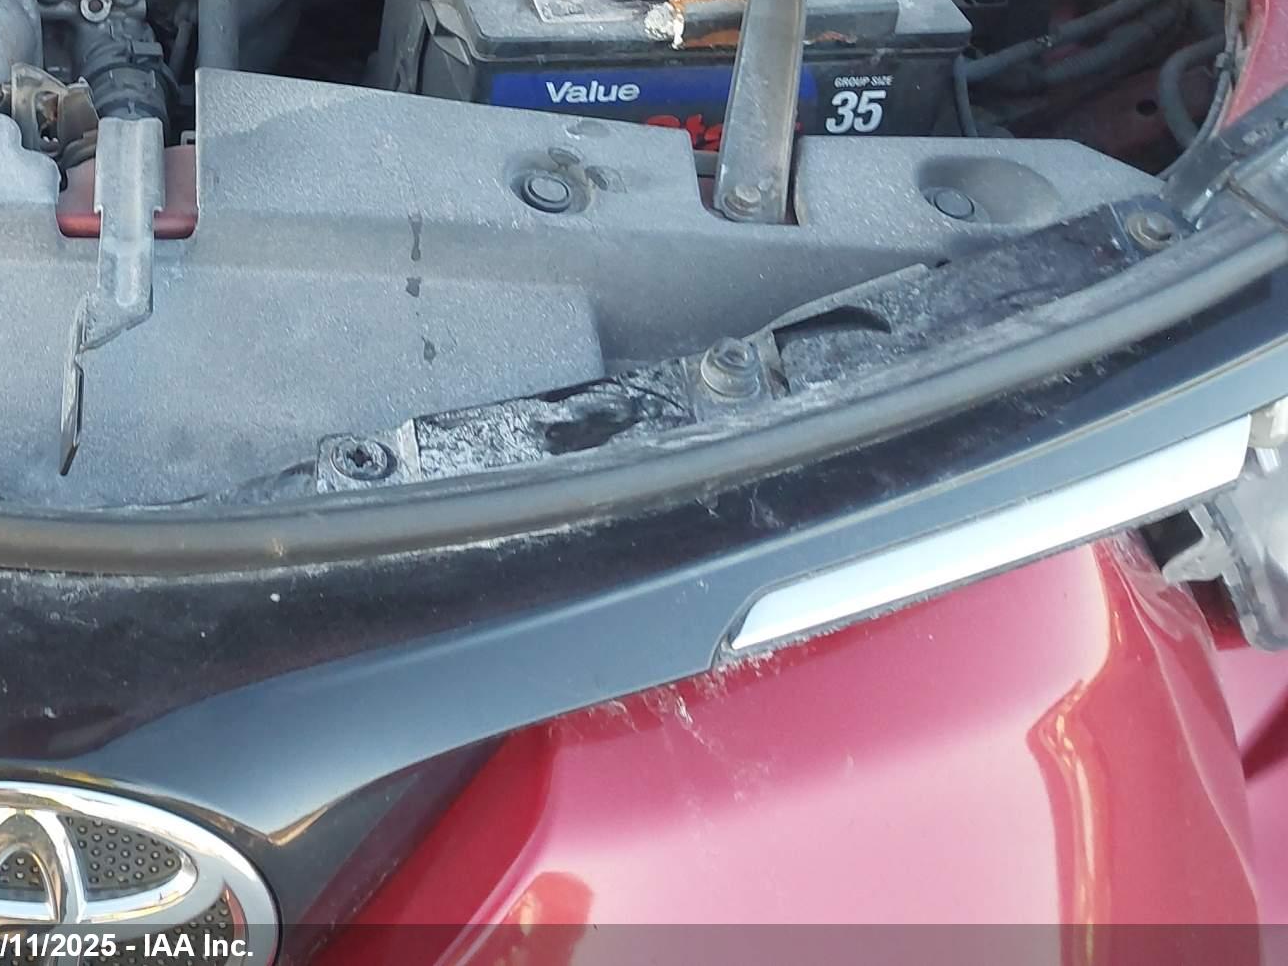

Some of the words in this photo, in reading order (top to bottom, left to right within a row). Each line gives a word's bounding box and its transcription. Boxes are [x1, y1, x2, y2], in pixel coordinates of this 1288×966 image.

[544, 80, 641, 103] Value
[833, 75, 870, 88] GROUP
[825, 89, 887, 134] 35
